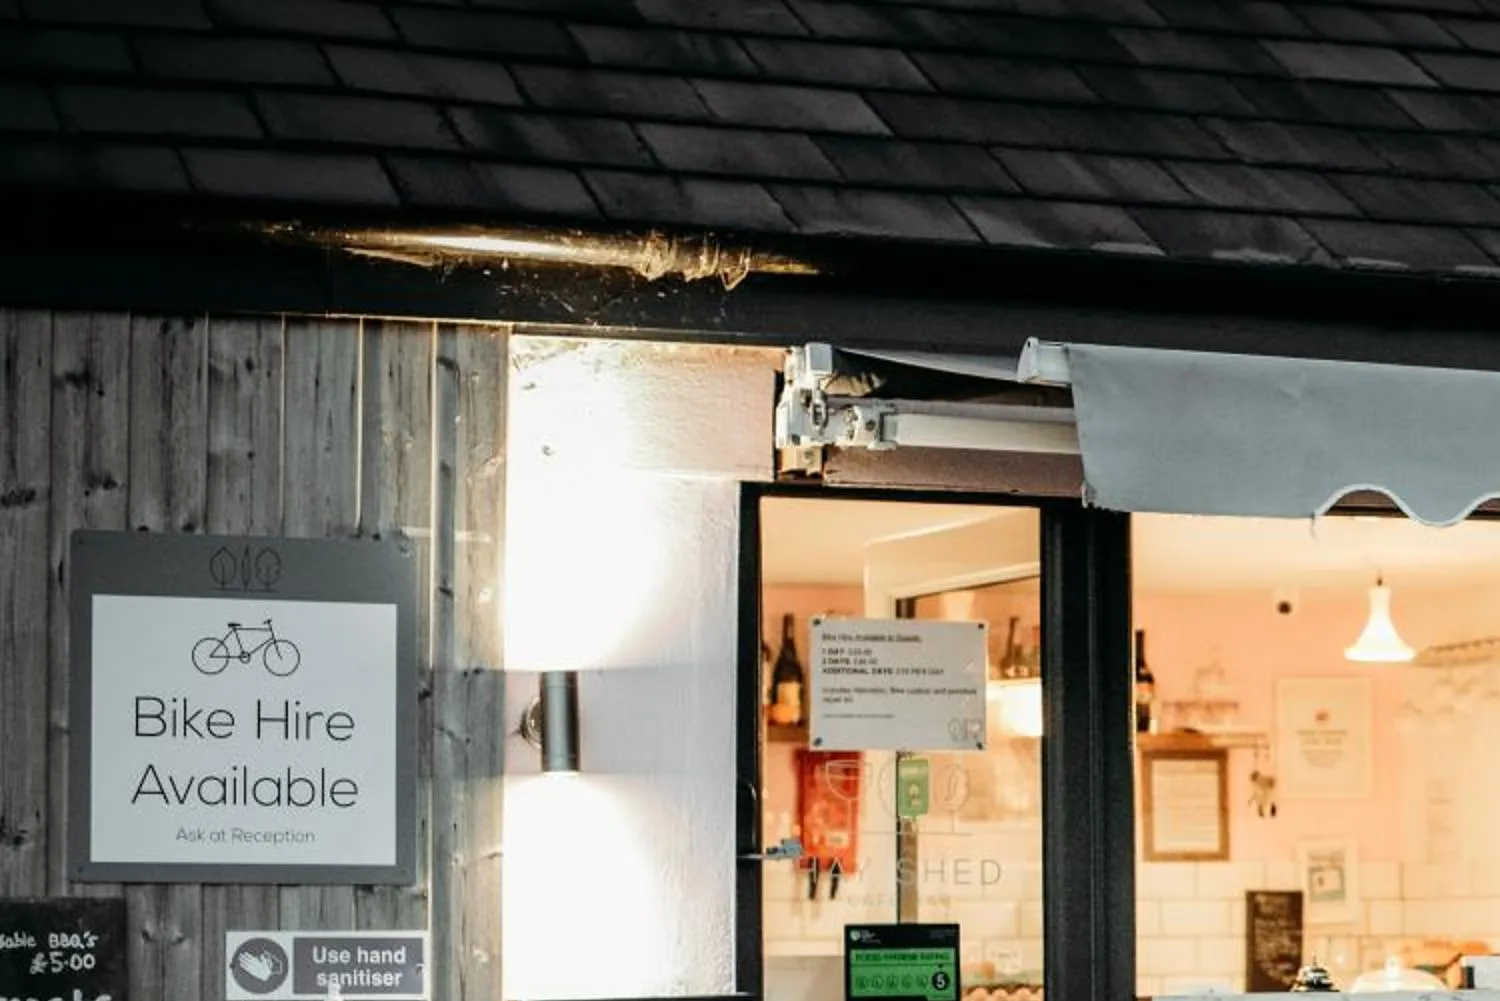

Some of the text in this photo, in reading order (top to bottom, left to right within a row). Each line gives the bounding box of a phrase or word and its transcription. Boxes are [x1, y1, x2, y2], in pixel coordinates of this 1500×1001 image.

[134, 696, 355, 741] Bike Hire
[131, 763, 359, 808] Available
[176, 826, 316, 846] Ask at Reception
[313, 945, 408, 965] Use hand
[316, 969, 404, 989] sanitiser
